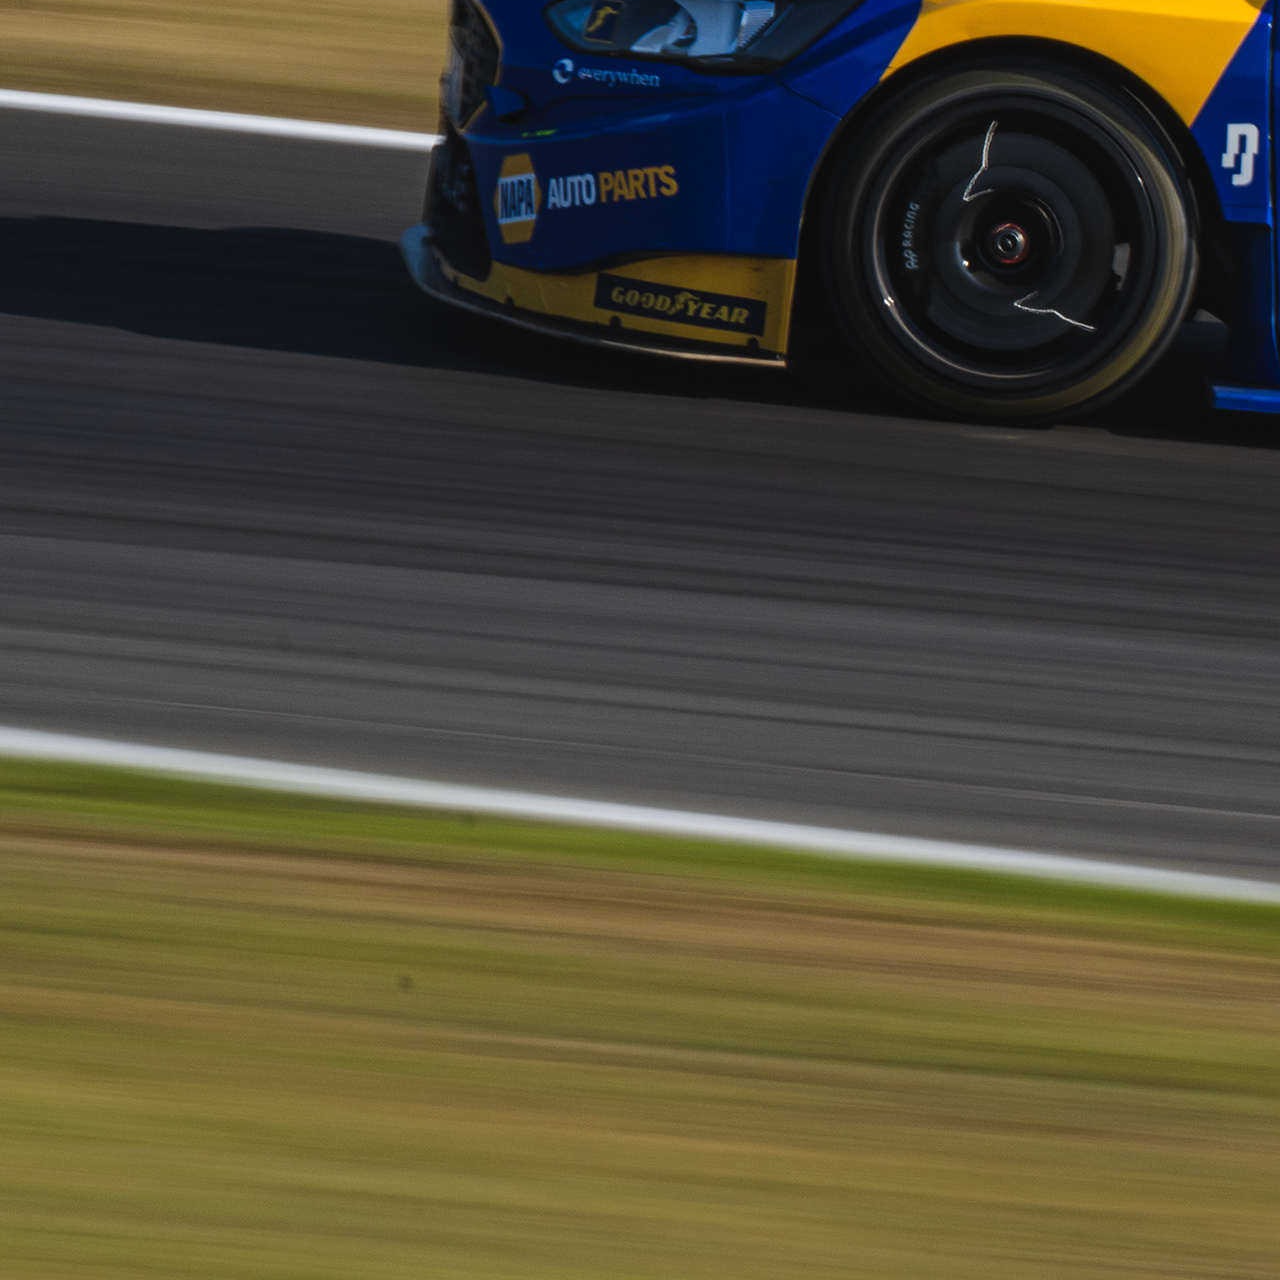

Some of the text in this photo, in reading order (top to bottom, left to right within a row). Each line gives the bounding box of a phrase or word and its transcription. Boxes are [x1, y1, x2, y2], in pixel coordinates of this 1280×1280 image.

[577, 67, 661, 88] everywhen
[500, 164, 679, 219] NAPA AUTO PARTS
[610, 286, 750, 325] GOODYEAR
